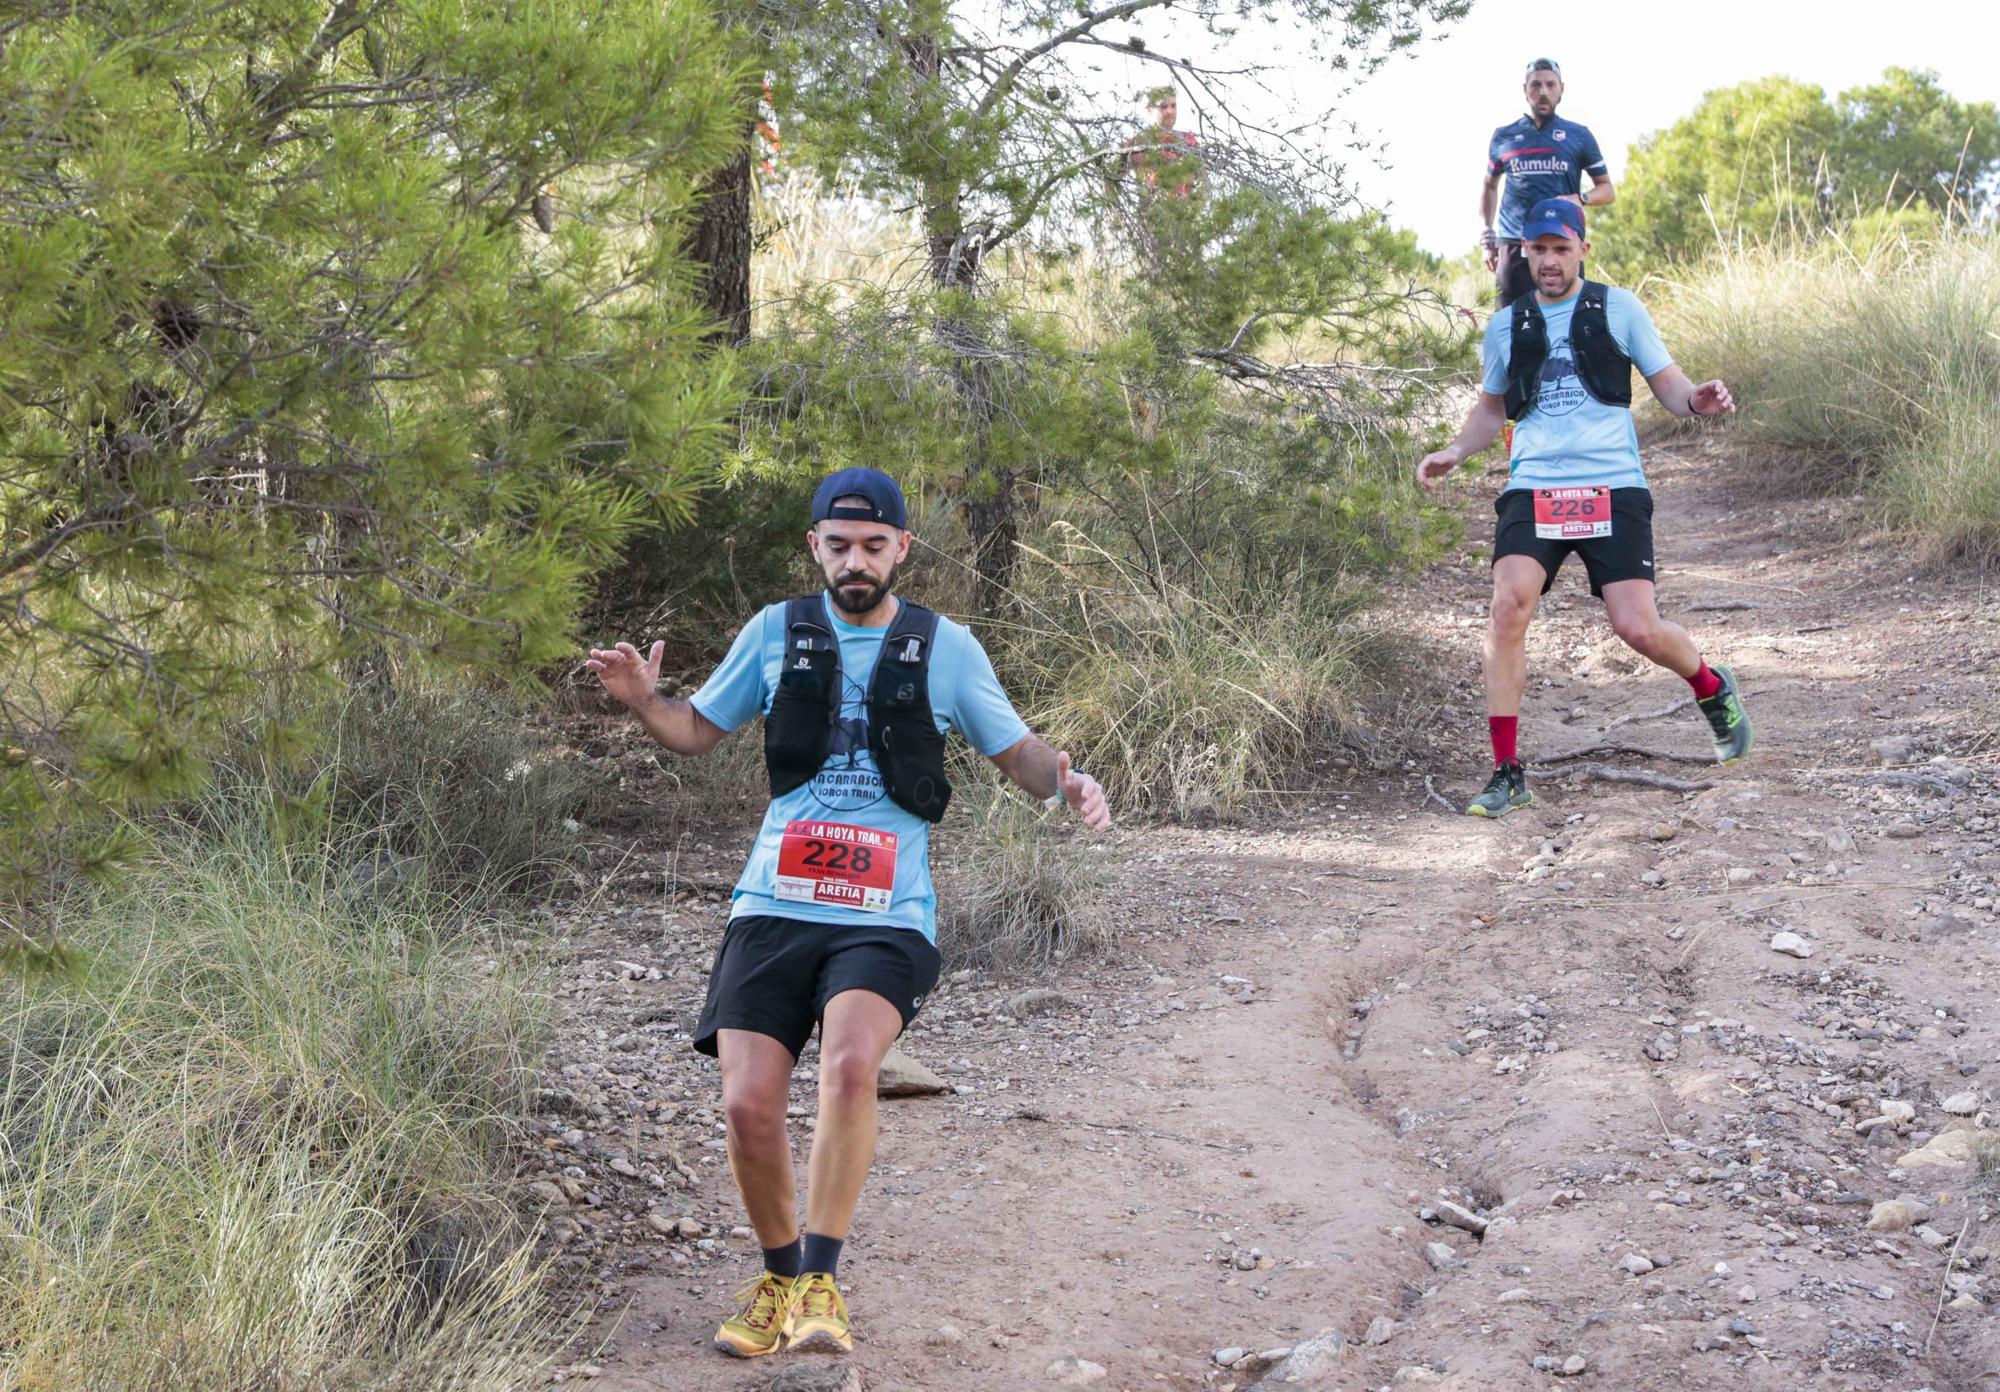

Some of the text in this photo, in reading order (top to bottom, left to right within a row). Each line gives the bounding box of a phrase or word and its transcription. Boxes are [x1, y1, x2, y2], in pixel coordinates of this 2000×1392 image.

[1510, 155, 1568, 172] Kumuka
[1552, 490, 1561, 498] LA
[1551, 499, 1595, 516] 226
[1563, 524, 1592, 533] ARETIA
[818, 788, 876, 800] LORCA TRAIL
[811, 825, 824, 838] LA
[826, 826, 855, 842] HOYA
[858, 830, 882, 846] TRAIL
[802, 840, 872, 873] 228
[817, 883, 861, 899] ARETIA
